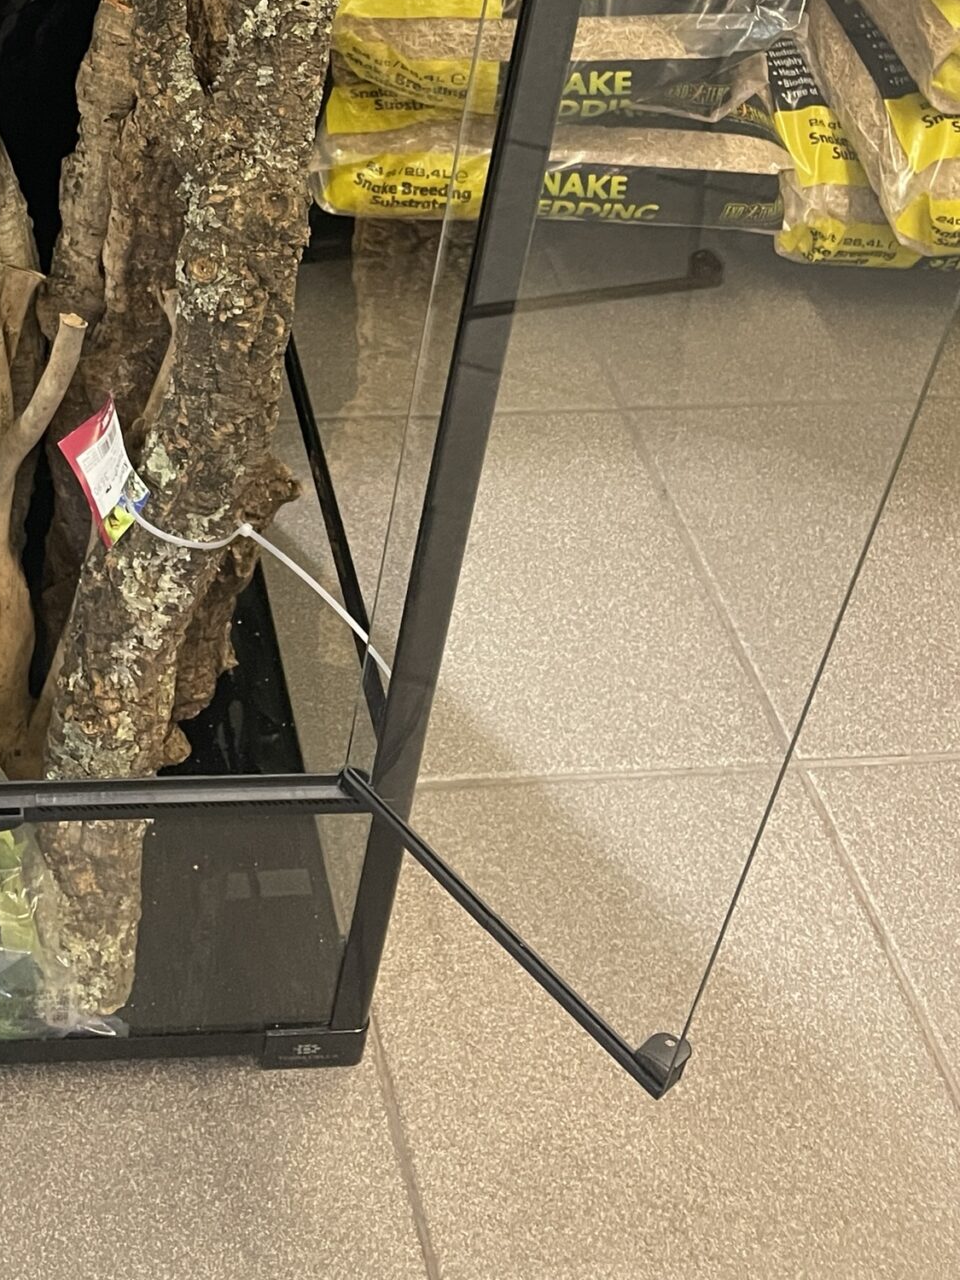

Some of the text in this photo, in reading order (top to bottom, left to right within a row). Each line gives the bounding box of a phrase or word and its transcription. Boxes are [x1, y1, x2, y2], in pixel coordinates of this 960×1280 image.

[562, 70, 633, 97] AKE
[352, 172, 398, 195] Snake
[542, 171, 629, 200] NAKE
[537, 199, 660, 220] EDDING
